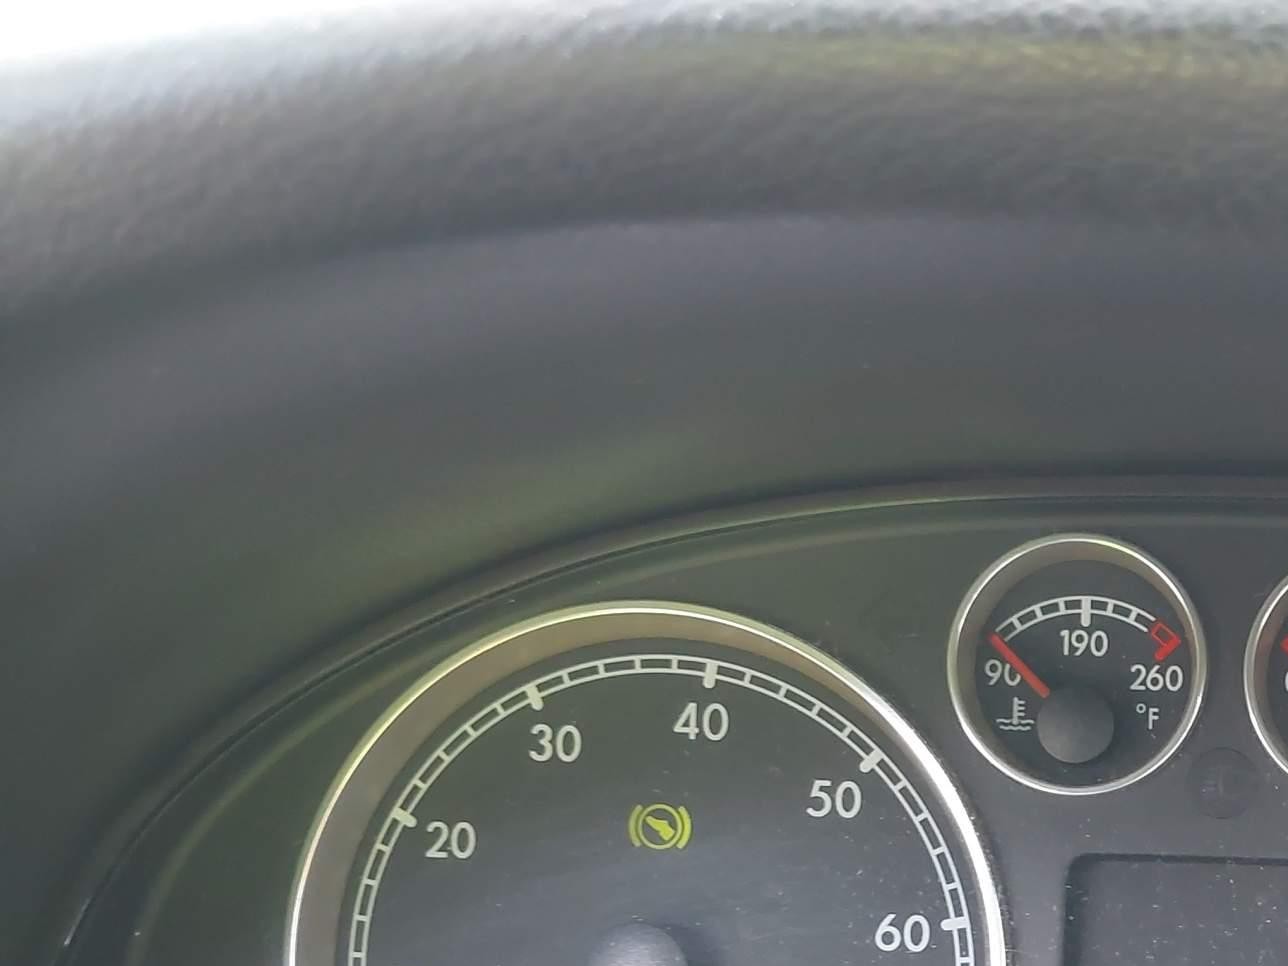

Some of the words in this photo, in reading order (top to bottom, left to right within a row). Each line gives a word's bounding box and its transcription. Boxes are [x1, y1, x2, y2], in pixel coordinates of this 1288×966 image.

[1060, 631, 1108, 657] 190
[1130, 665, 1183, 692] 260
[674, 704, 729, 741] 40
[529, 725, 582, 762] 30
[806, 781, 861, 819] 50
[425, 822, 476, 859] 20
[874, 914, 930, 953] 60
